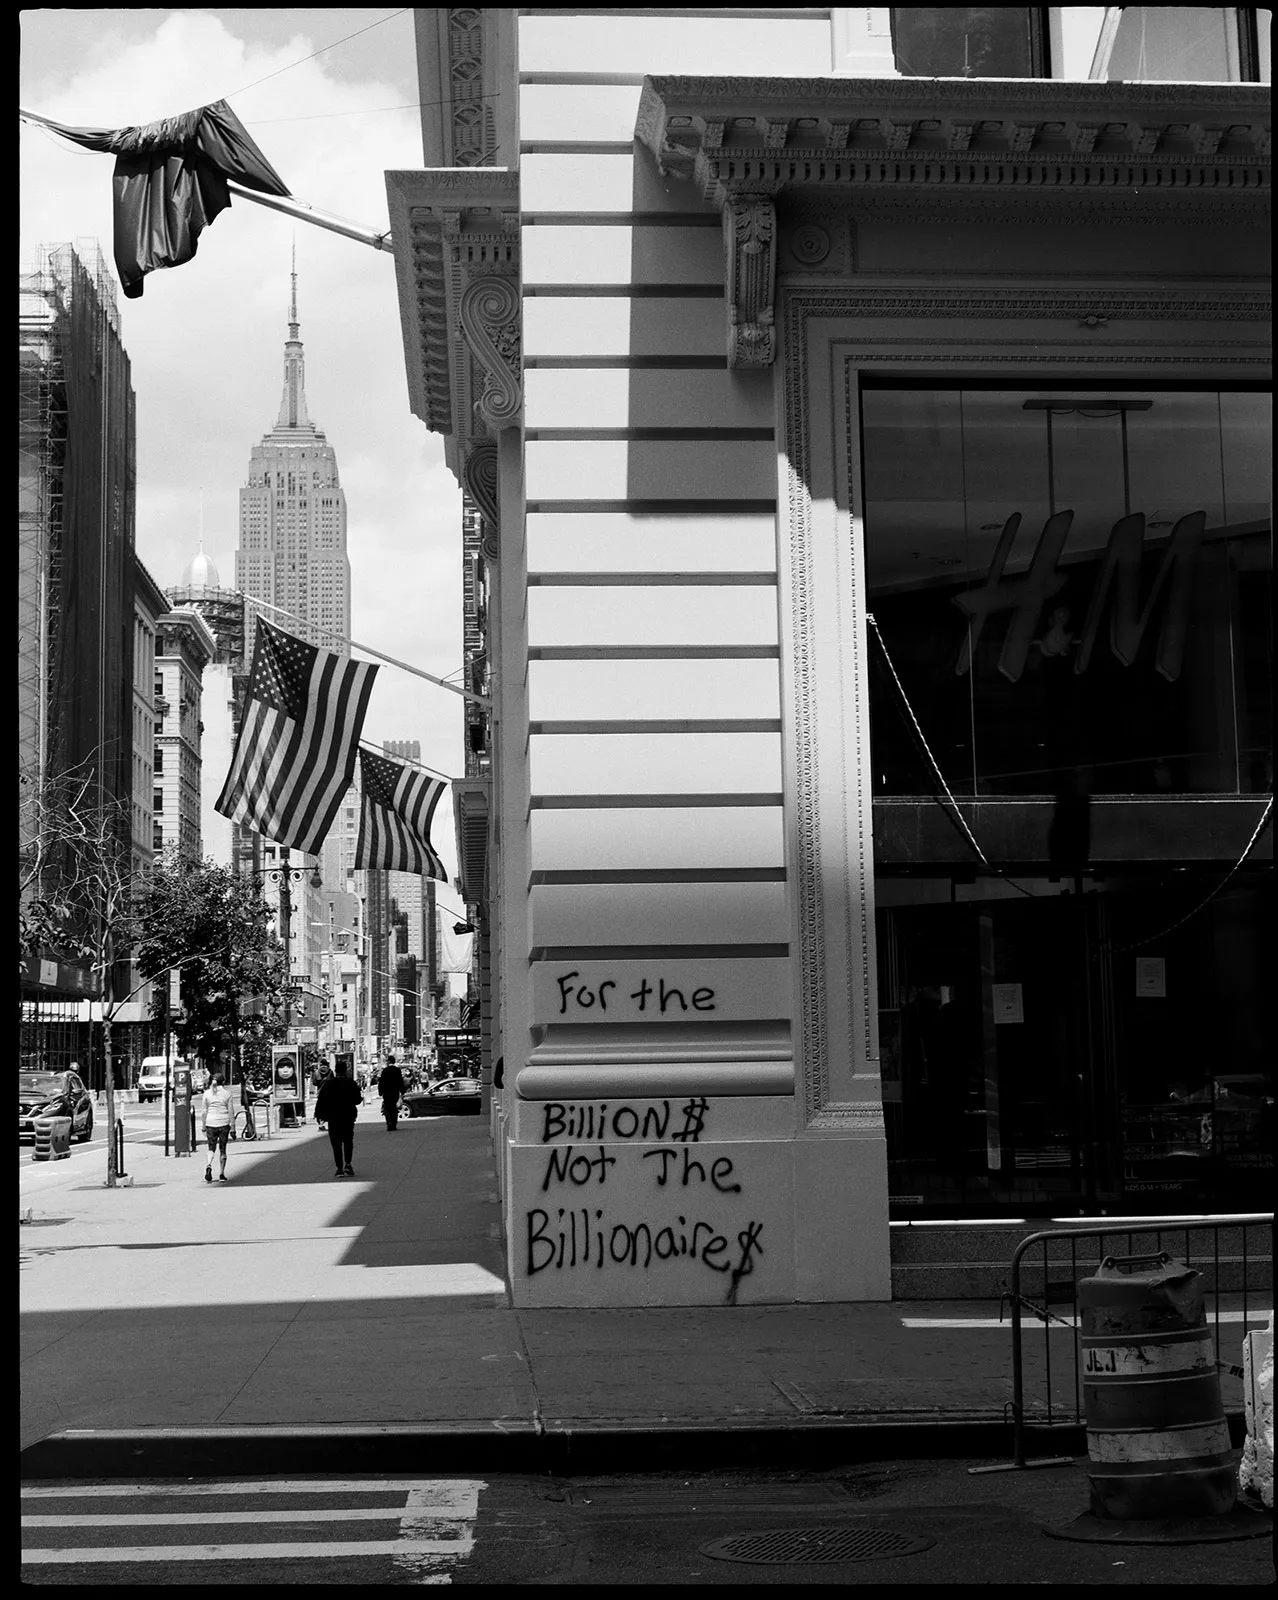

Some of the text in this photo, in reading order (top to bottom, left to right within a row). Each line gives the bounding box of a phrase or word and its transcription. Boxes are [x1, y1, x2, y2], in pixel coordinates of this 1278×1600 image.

[950, 510, 1207, 683] H&M
[557, 971, 717, 1015] For the
[178, 1072, 186, 1082] P
[542, 1146, 742, 1193] Not The
